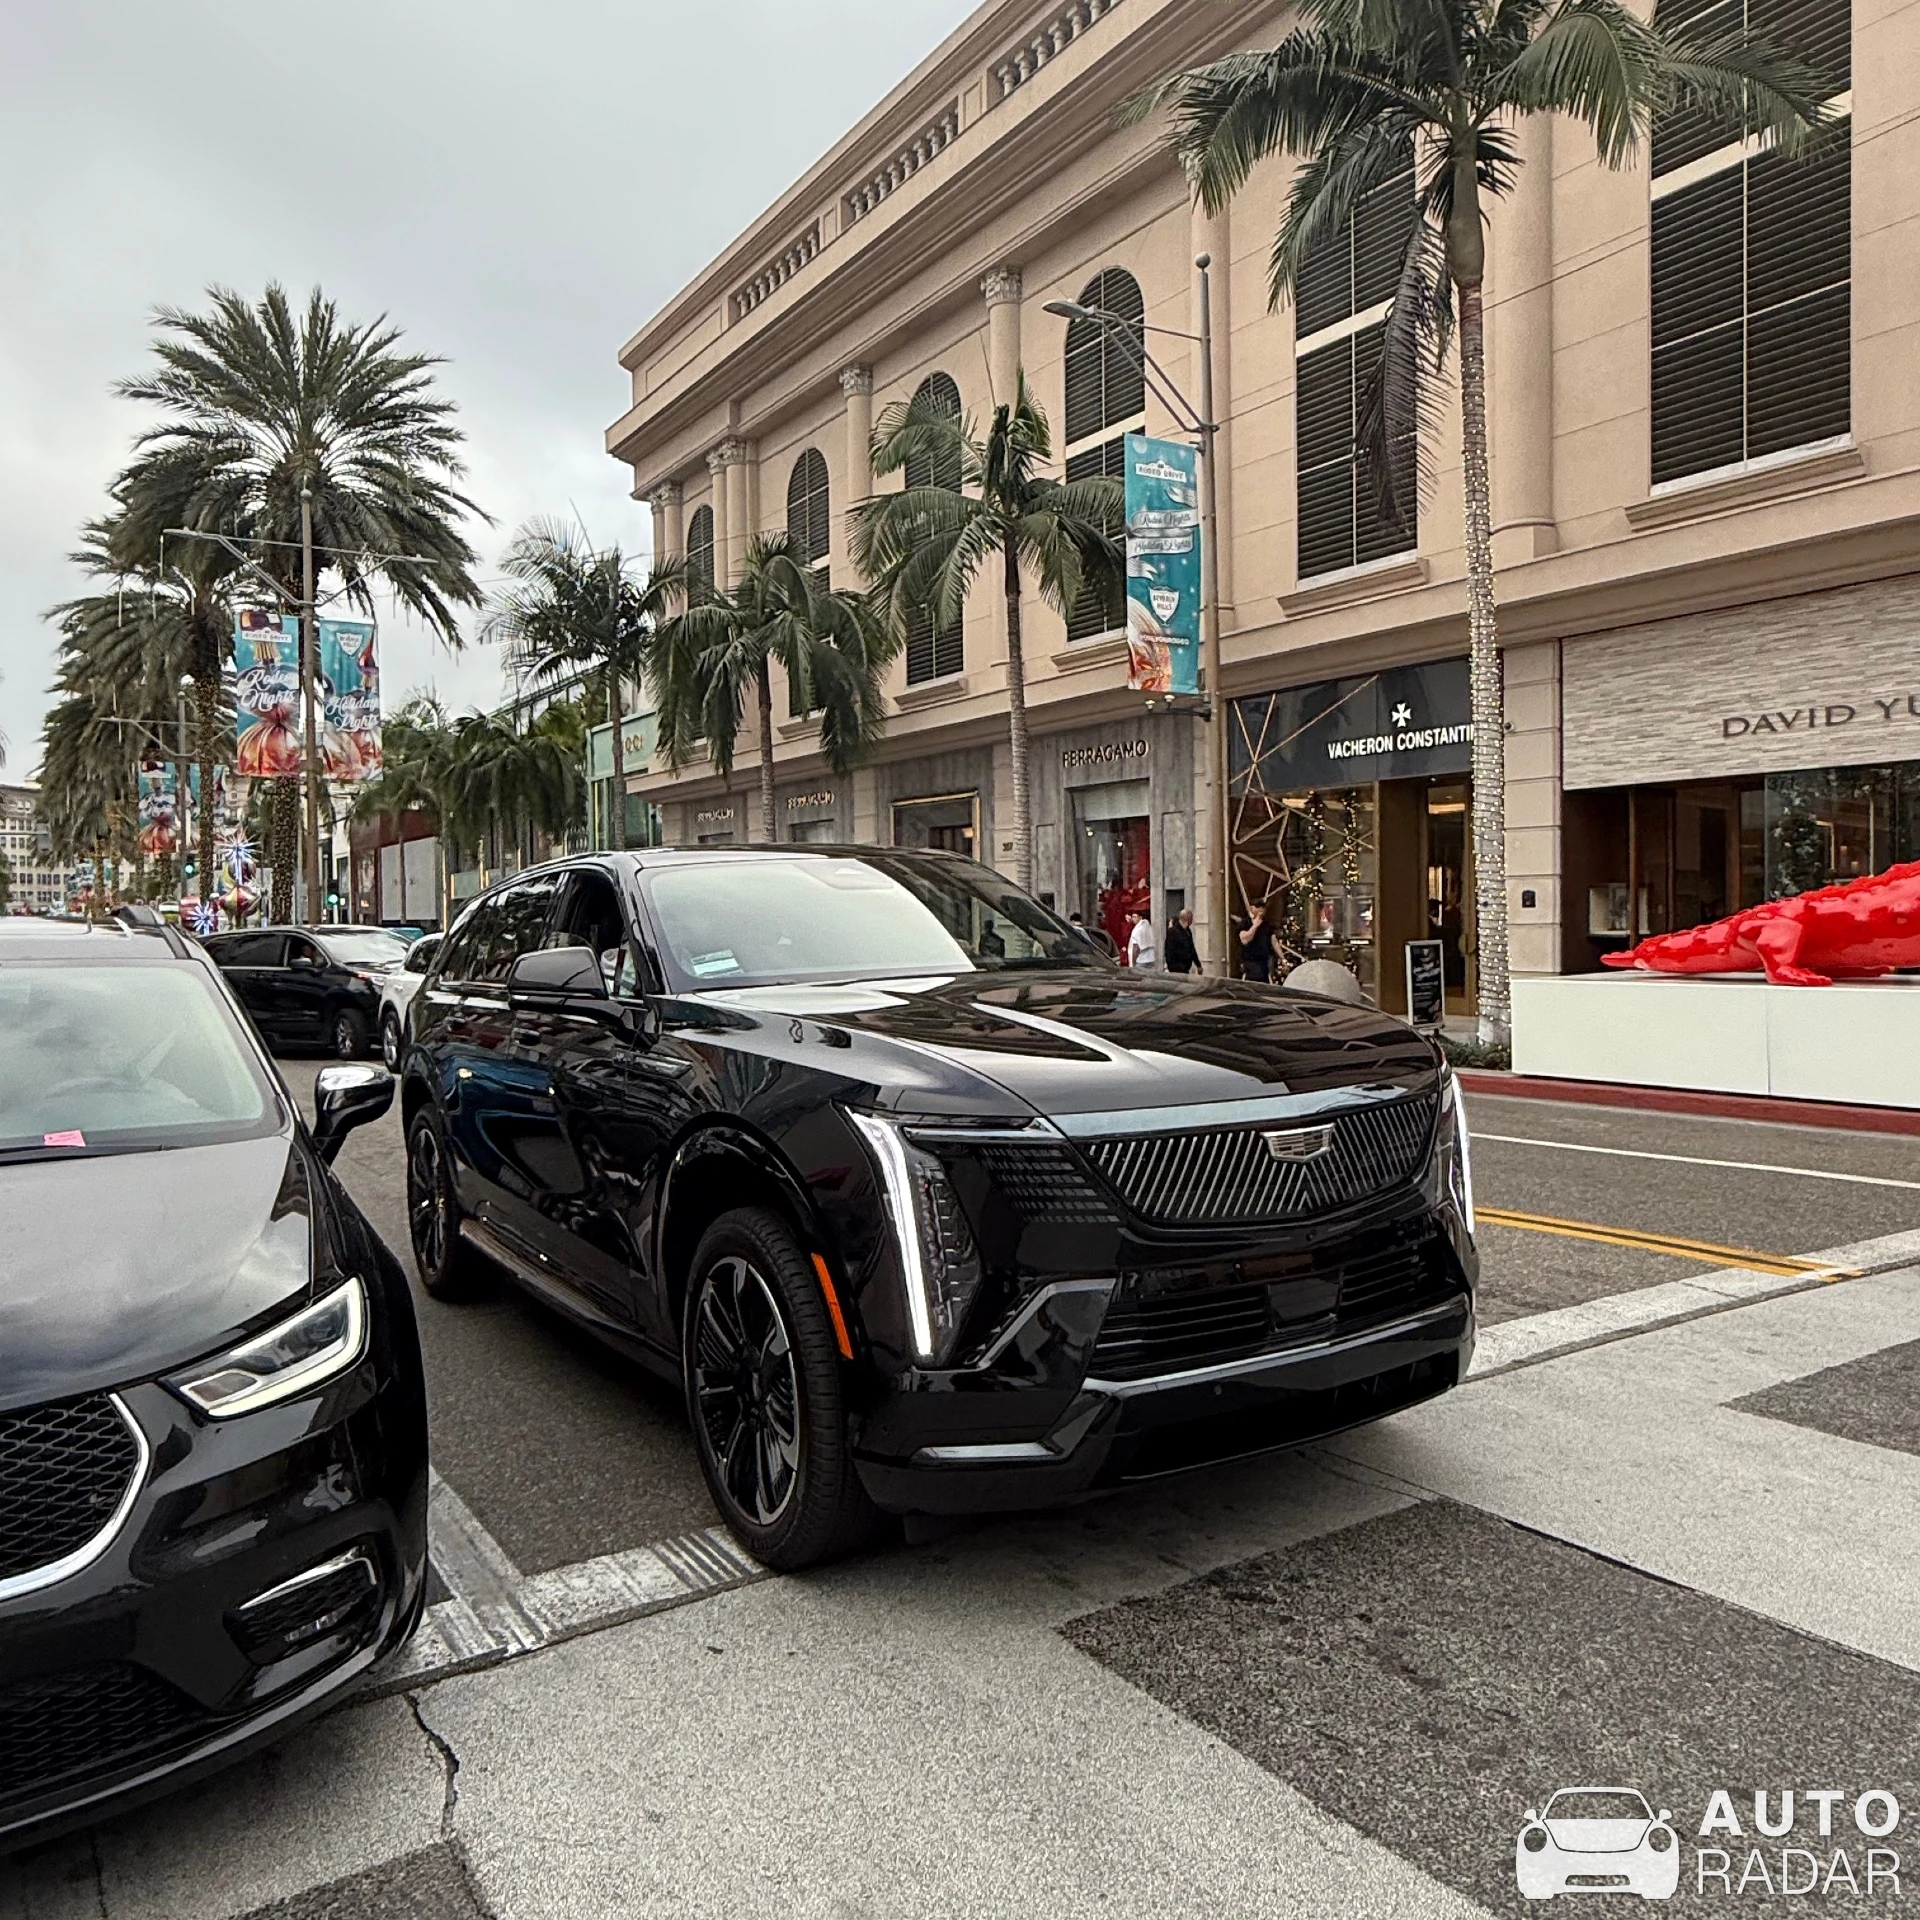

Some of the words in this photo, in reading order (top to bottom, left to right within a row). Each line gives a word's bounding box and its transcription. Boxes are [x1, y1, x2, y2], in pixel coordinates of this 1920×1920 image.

[1139, 466, 1161, 477] RODEO
[1164, 470, 1184, 480] DRIVE
[240, 689, 296, 712] Nights
[334, 712, 380, 733] Lights
[1723, 704, 1857, 739] DAVID
[1062, 739, 1151, 768] FERRAGAMO
[1327, 734, 1394, 761] VACHERON
